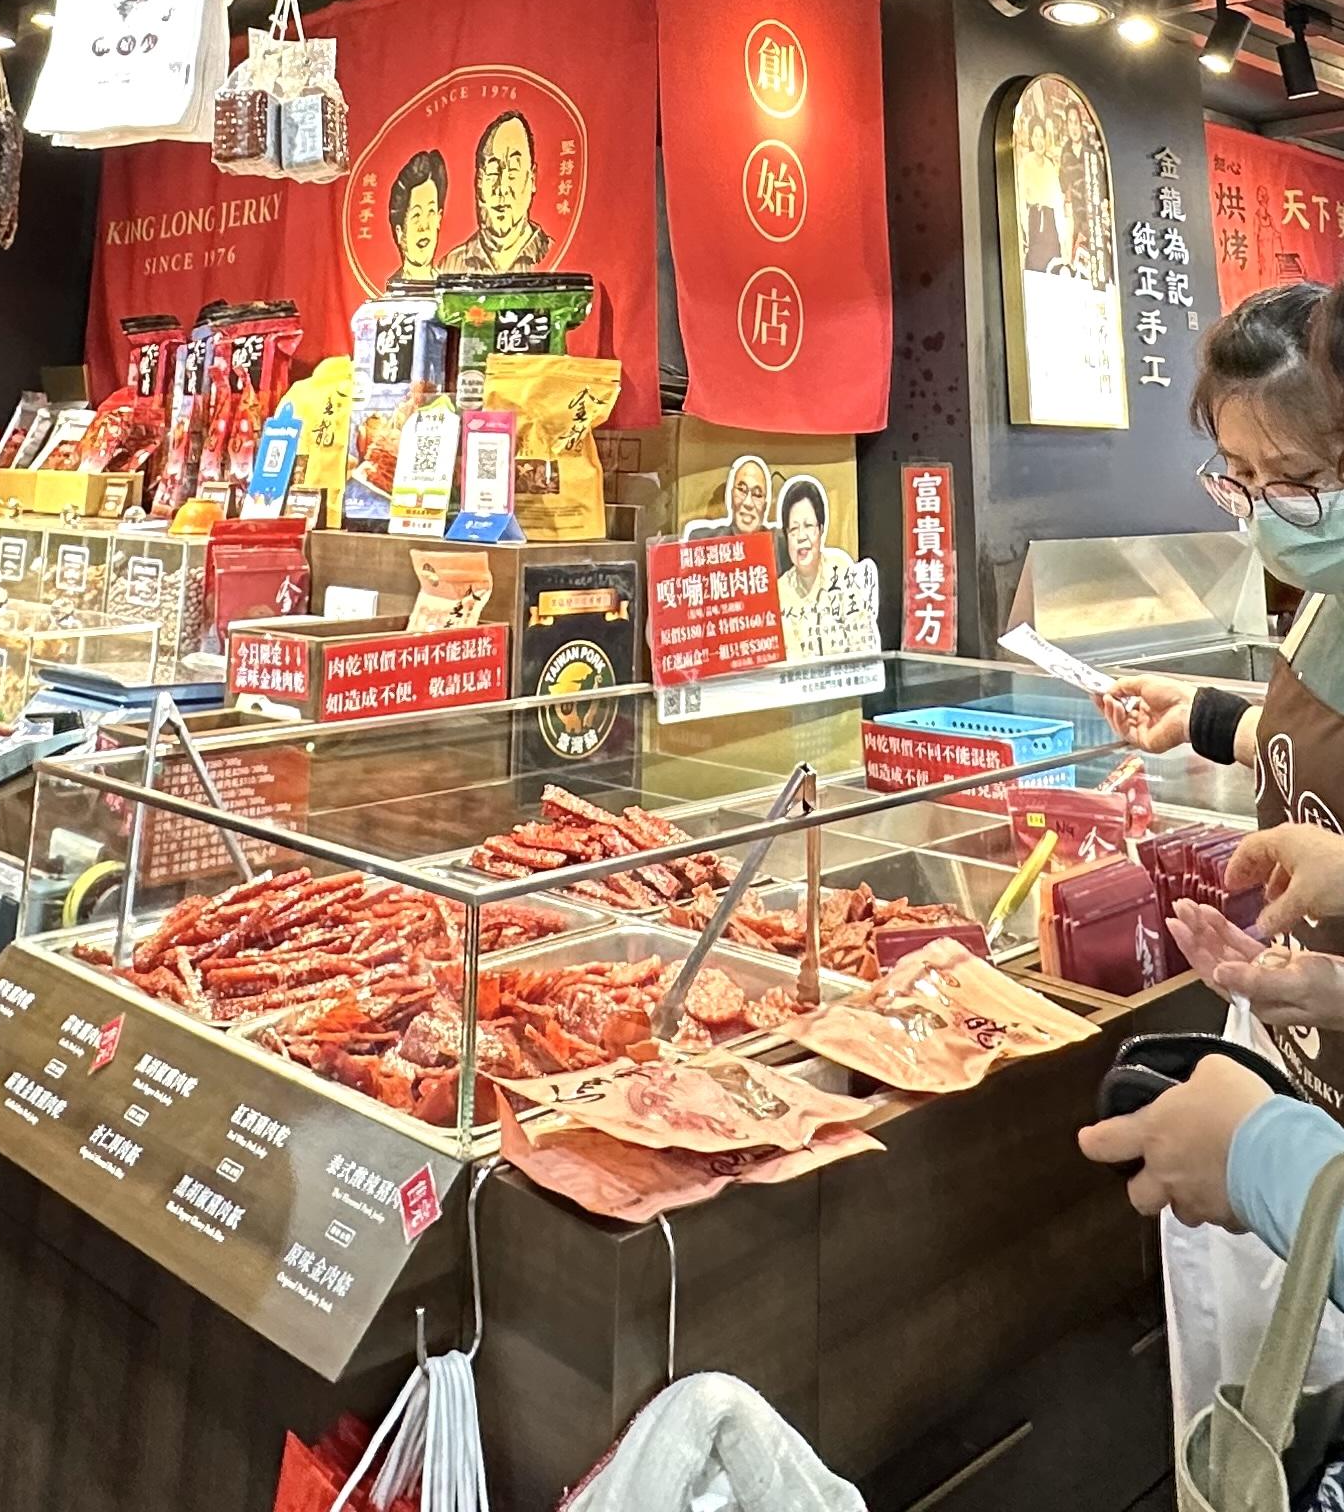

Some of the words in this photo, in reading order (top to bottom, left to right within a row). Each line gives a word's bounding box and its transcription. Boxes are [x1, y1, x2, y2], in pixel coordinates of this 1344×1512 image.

[426, 87, 469, 117] SINCE
[481, 85, 518, 100] 1976
[359, 172, 378, 240] 純正手工
[556, 139, 576, 215] 堅持好味
[752, 36, 796, 347] 創始店
[107, 216, 155, 245] KING
[160, 206, 214, 238] LONG
[219, 192, 283, 234] JERKY
[1155, 146, 1194, 307] 金龍為記
[1214, 182, 1249, 272] 烘烤
[144, 252, 193, 276] SINCE
[204, 245, 236, 268] 1976
[1131, 221, 1171, 388] 純正手工
[912, 472, 946, 645] 富貴雙方
[545, 646, 581, 683] TAIWAN
[580, 646, 606, 675] PORK
[1302, 1068, 1344, 1110] JERKY
[325, 1153, 406, 1213] 泰式酸辣豬肉
